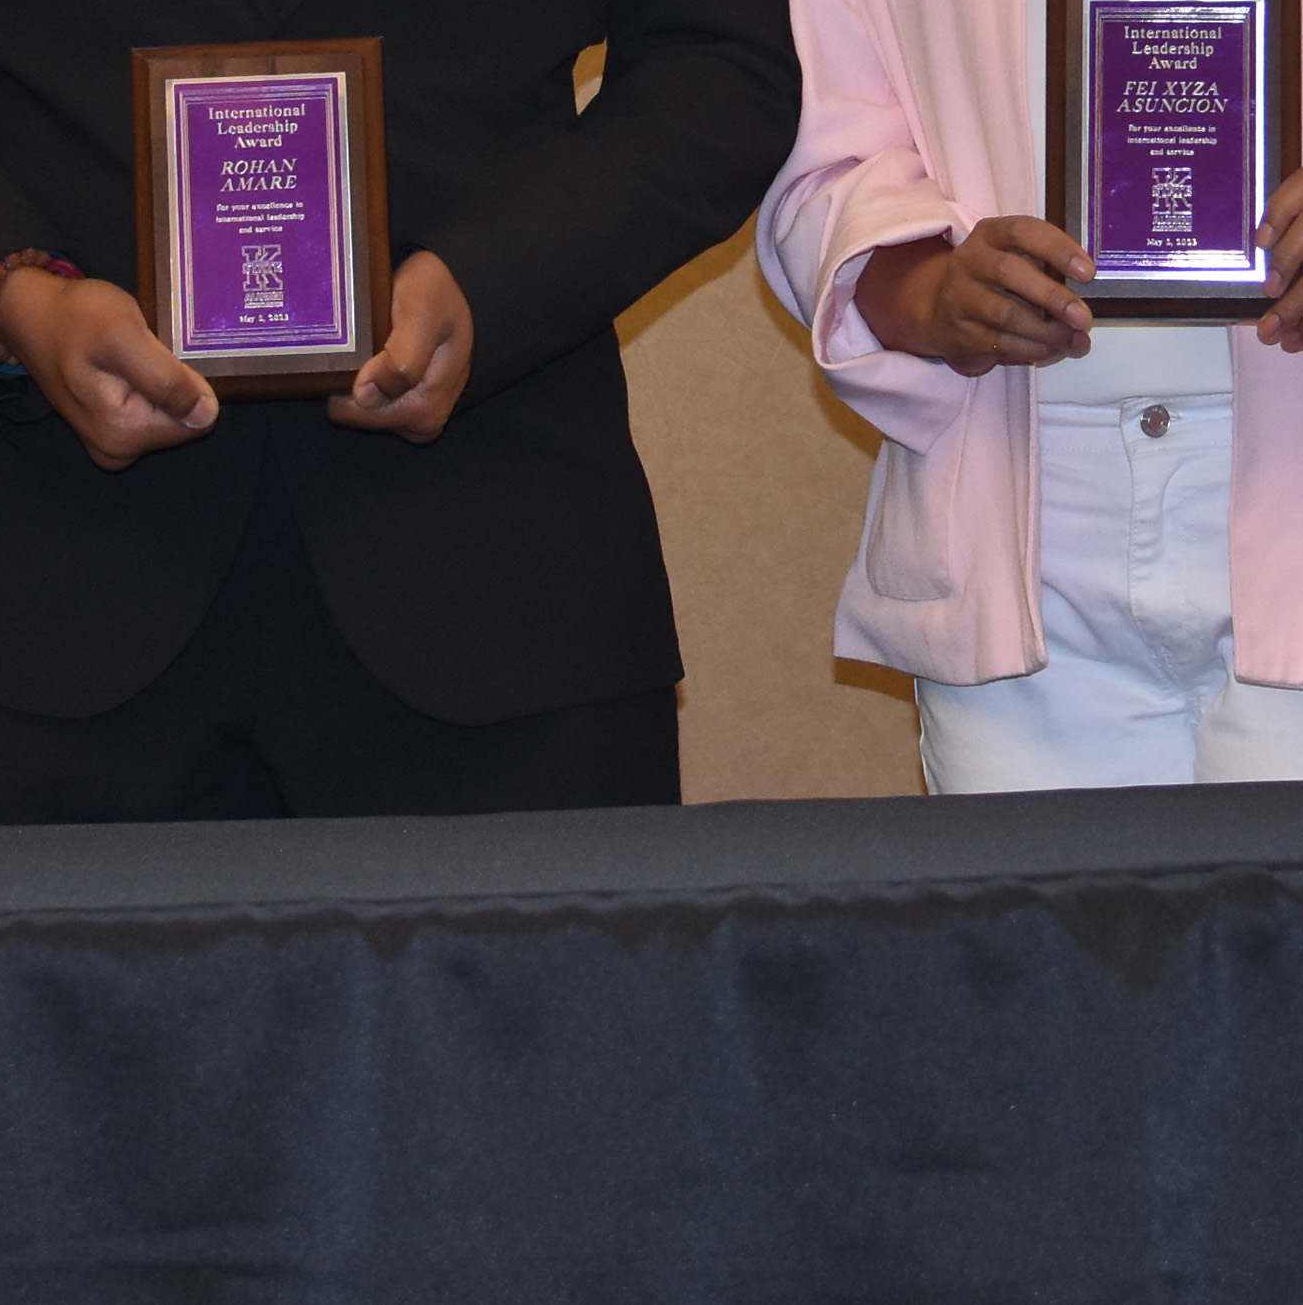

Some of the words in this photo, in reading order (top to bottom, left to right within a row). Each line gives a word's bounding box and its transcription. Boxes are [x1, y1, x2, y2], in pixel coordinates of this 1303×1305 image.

[1124, 25, 1222, 39] International
[1132, 41, 1214, 57] Leadership
[1148, 56, 1198, 69] Award
[1123, 81, 1157, 96] FEI
[1162, 81, 1219, 96] XYZA
[208, 103, 305, 119] International
[1116, 97, 1229, 113] ASUNCION
[217, 119, 298, 135] Leadership
[234, 134, 282, 149] Award
[220, 158, 297, 175] ROHAN
[220, 175, 297, 192] AMARE
